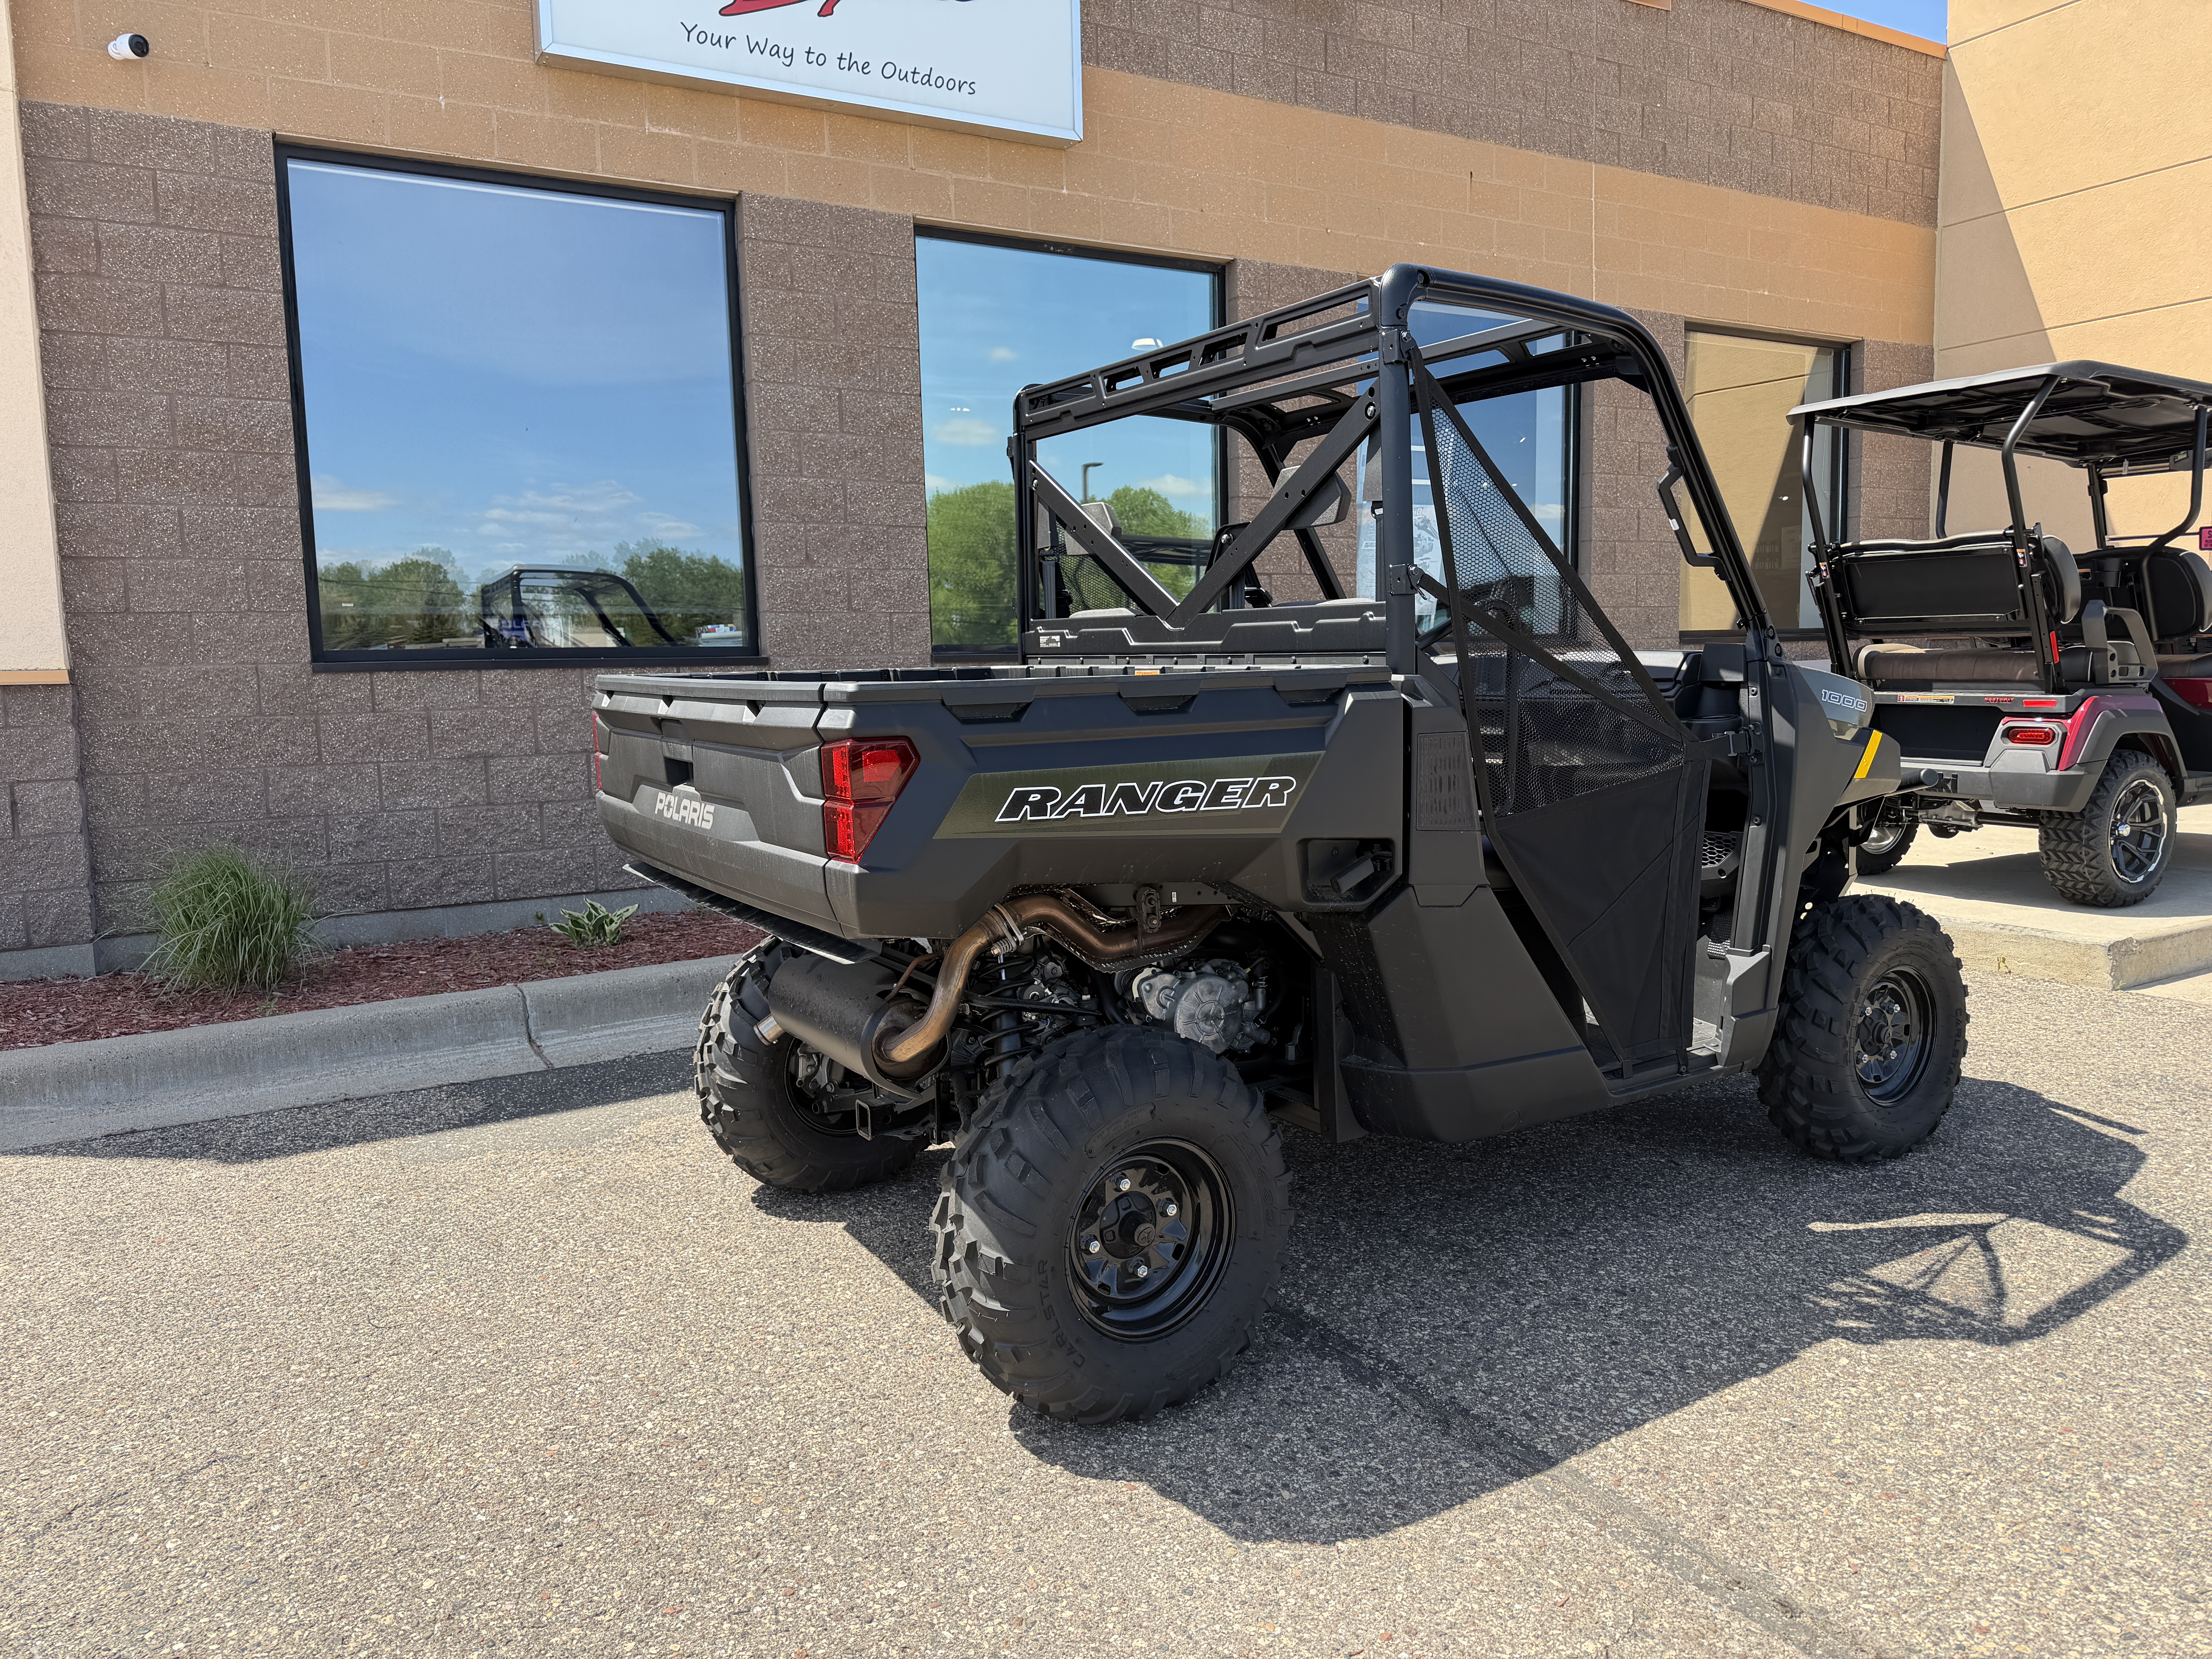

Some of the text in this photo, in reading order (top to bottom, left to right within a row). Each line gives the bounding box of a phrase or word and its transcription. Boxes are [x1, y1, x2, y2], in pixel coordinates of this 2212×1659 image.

[680, 22, 976, 95] Your Way to the Outdoors
[1821, 689, 1867, 712] 1000
[655, 792, 715, 830] POLARIS
[995, 776, 1297, 822] RANGER
[1037, 1258, 1085, 1369] CARLSTAR
